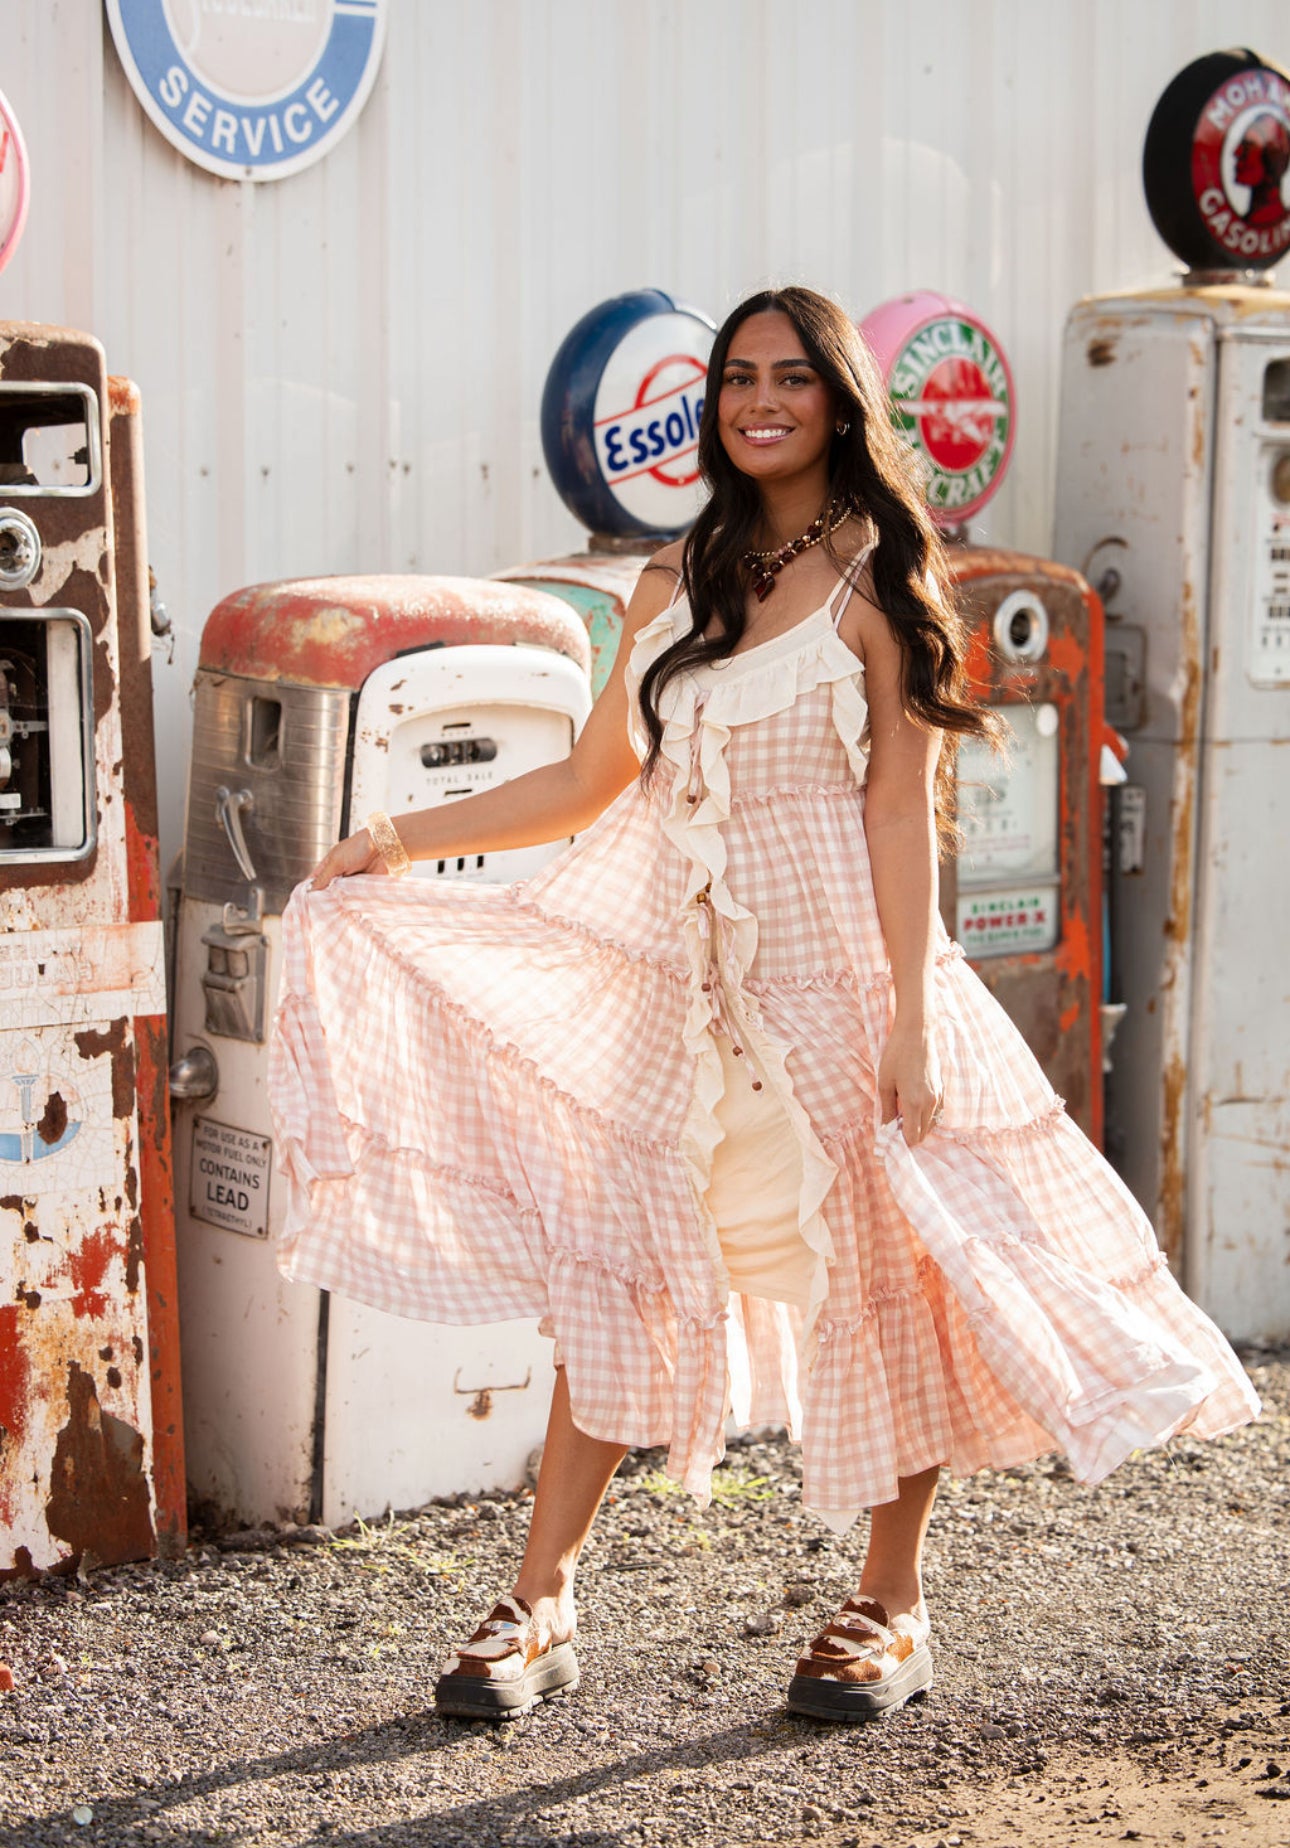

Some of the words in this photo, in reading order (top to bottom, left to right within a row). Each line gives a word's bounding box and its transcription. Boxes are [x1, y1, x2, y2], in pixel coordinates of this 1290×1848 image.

[158, 65, 340, 157] SERVICE
[894, 323, 1007, 397] SINCLAIR
[899, 426, 1006, 507] CRAFT
[971, 896, 1040, 915] SINCLAIR
[203, 1126, 219, 1138] FOR
[220, 1131, 236, 1144] USE
[238, 1137, 251, 1149] AS
[252, 1141, 260, 1151] A
[223, 1147, 243, 1163] FUEL
[245, 1154, 267, 1168] ONLY
[199, 1158, 260, 1190] CONTAINS
[206, 1181, 250, 1212] LEAD
